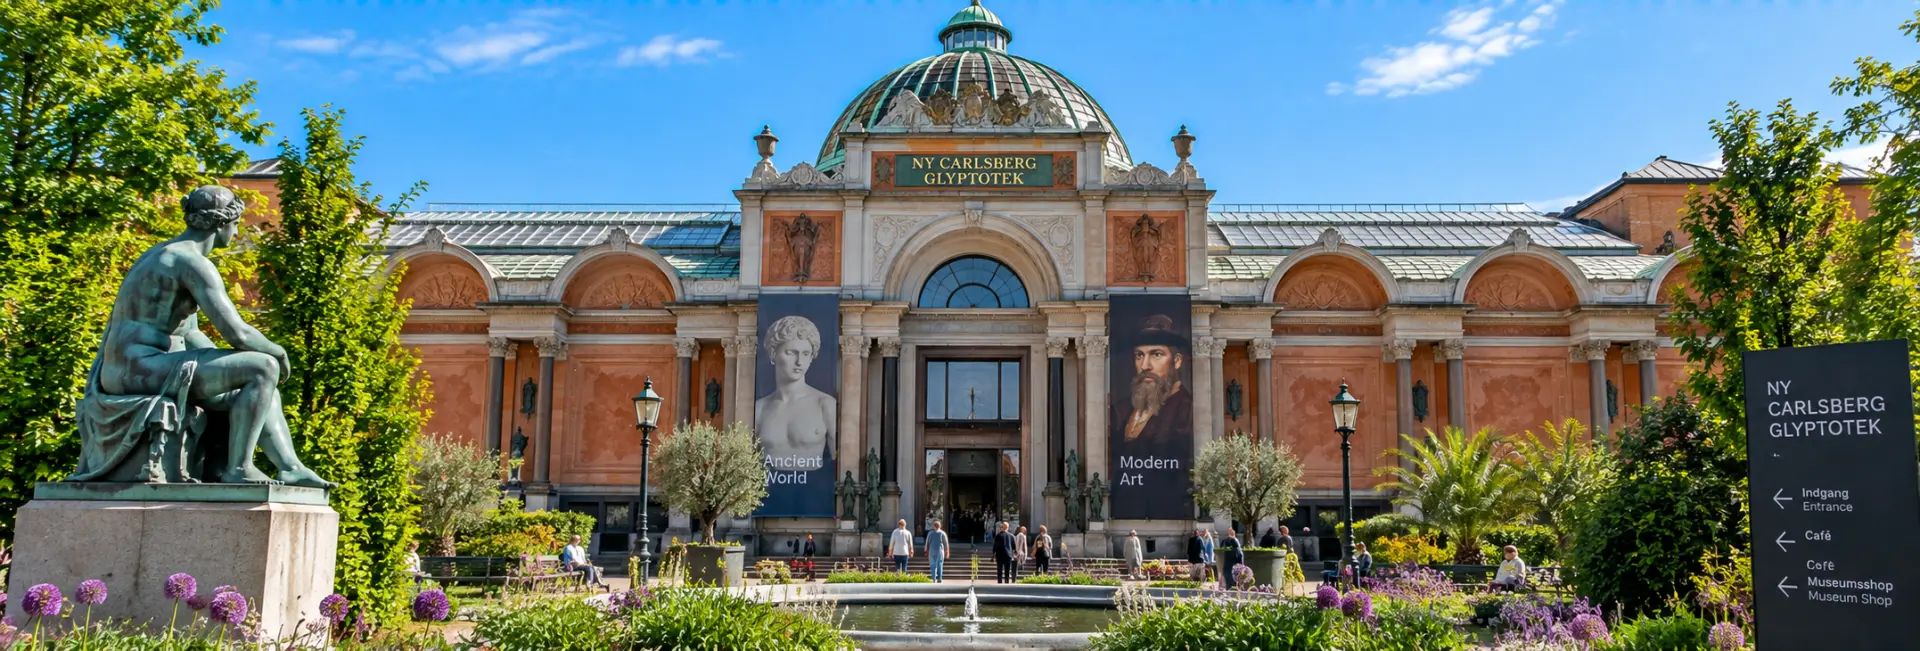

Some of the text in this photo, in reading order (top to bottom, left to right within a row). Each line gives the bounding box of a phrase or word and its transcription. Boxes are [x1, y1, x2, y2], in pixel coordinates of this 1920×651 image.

[912, 157, 1037, 170] NY CARLSBERG
[924, 172, 1024, 185] GLYPTOTEK
[1767, 380, 1791, 396] NY
[1768, 396, 1885, 417] CARLSBERG
[1769, 418, 1882, 438] GLYPTOTEK
[763, 454, 823, 468] Ancient
[1120, 455, 1179, 469] Modern
[1120, 472, 1144, 486] Art
[1802, 487, 1849, 500] Indgang
[1803, 501, 1853, 512] Entrance
[1807, 576, 1893, 593] Museumsshop
[1808, 590, 1893, 608] Museum Shop
